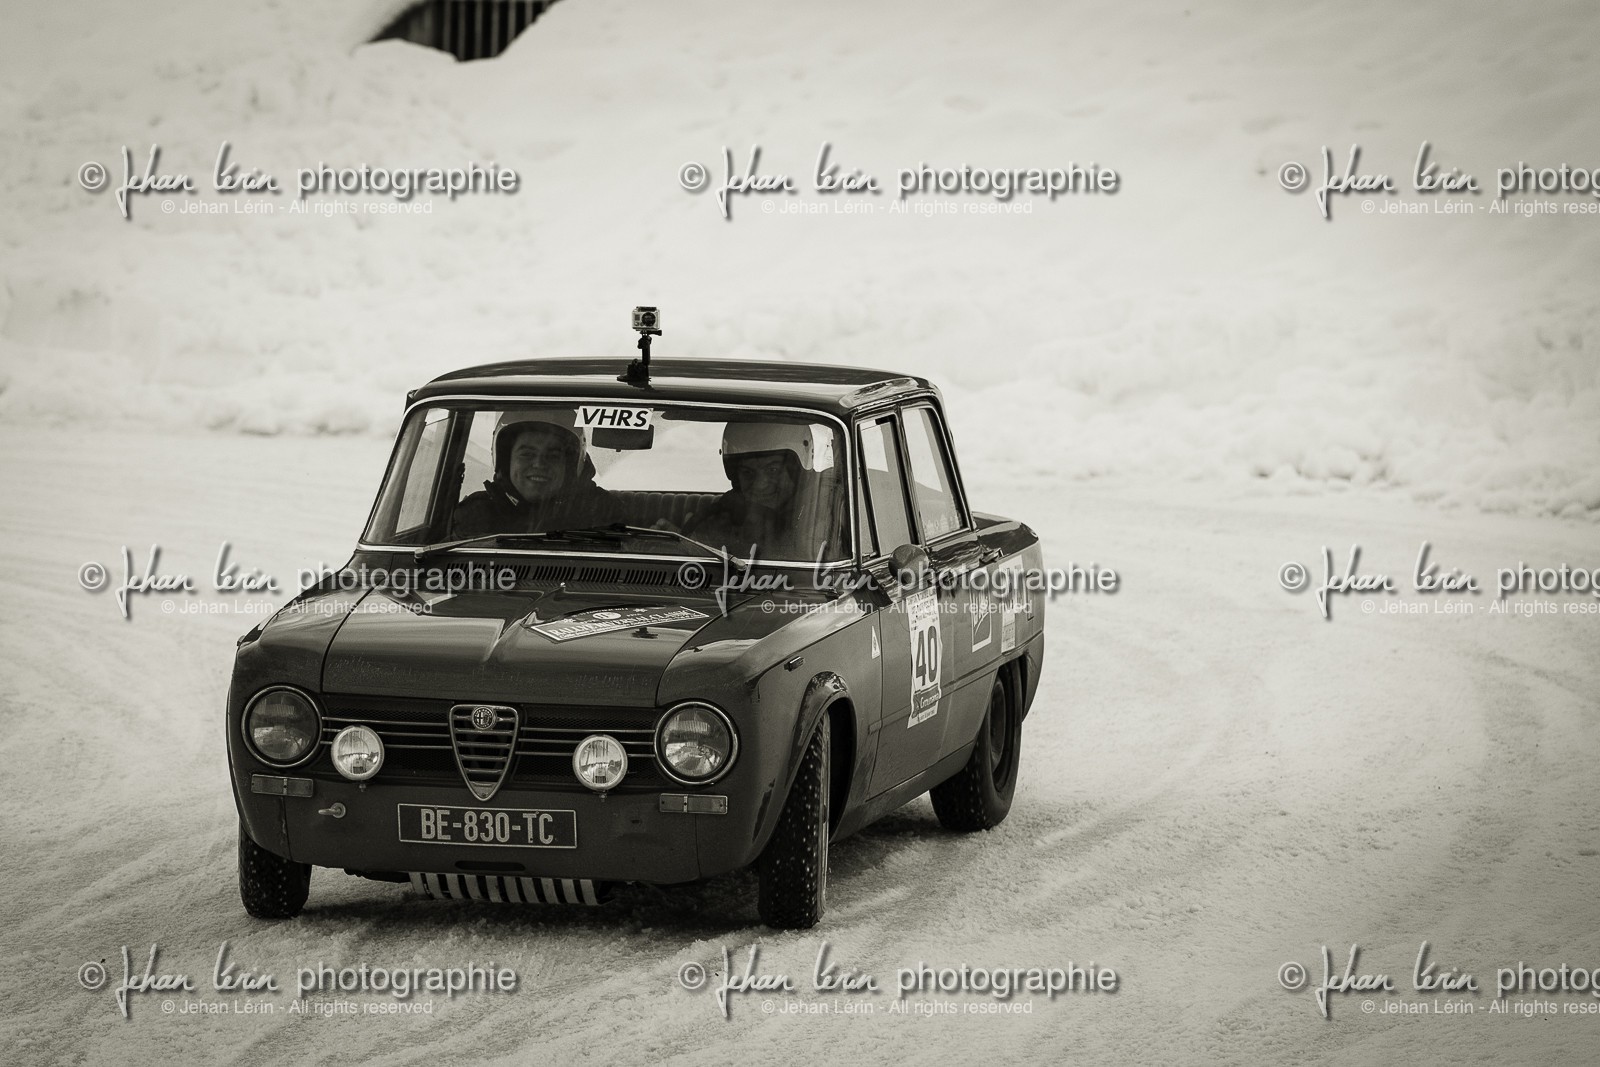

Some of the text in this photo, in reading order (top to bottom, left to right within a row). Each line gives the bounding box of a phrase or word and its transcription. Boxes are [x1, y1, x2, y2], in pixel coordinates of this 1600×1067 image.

[582, 407, 649, 428] VHRS
[916, 626, 938, 686] 40
[420, 808, 553, 845] BE-830-TC
